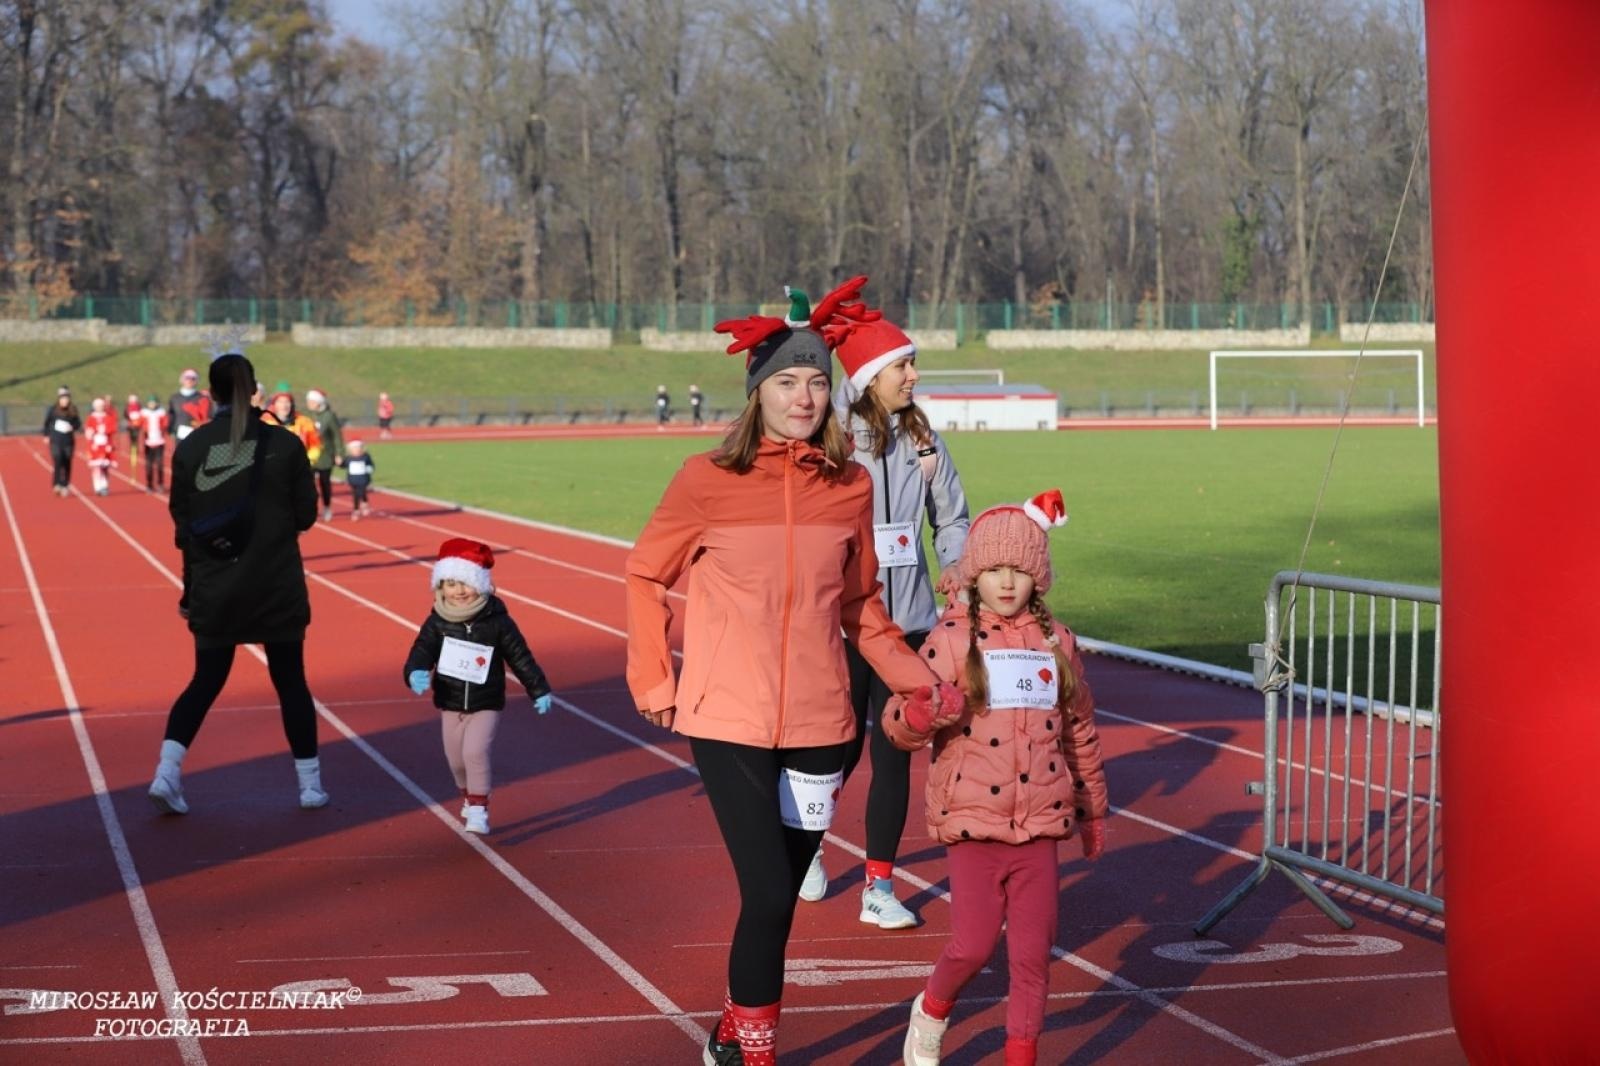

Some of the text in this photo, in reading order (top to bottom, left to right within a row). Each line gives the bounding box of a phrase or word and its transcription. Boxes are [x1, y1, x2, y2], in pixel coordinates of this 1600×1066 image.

[888, 544, 896, 556] 3
[457, 659, 470, 670] 32
[1015, 678, 1033, 692] 48
[807, 802, 825, 815] 82
[1152, 934, 1404, 964] 3
